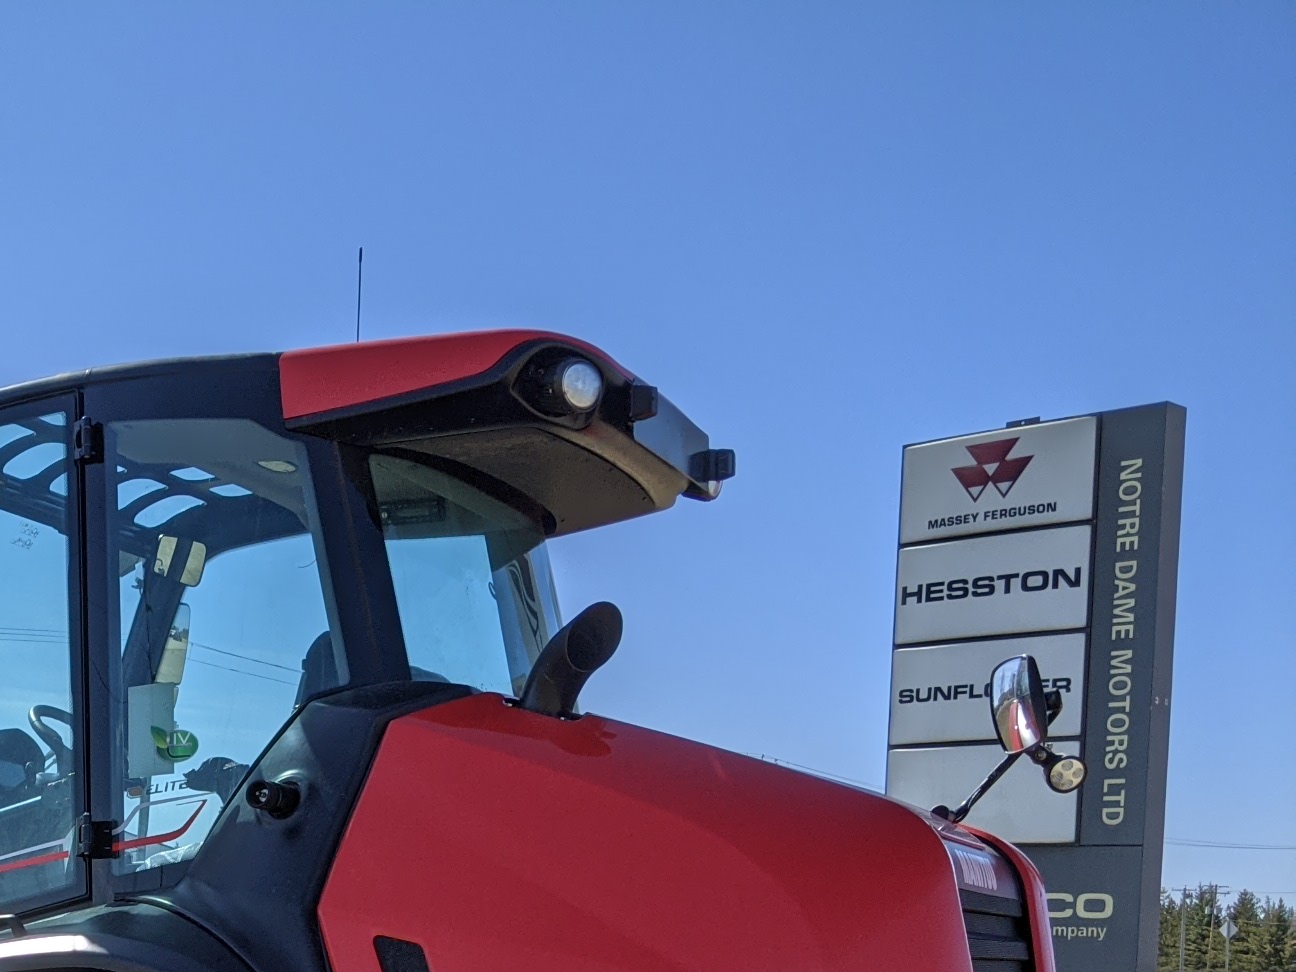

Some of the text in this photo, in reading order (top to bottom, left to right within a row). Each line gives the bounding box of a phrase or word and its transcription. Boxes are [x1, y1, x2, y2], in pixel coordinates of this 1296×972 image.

[927, 502, 1057, 530] MASSEY FERGUSON
[901, 567, 1082, 606] HESSTON
[1101, 458, 1143, 826] NOTRE DAME MOTORS LTD
[898, 677, 1072, 704] SUNFLER
[1052, 925, 1107, 941] mpany
